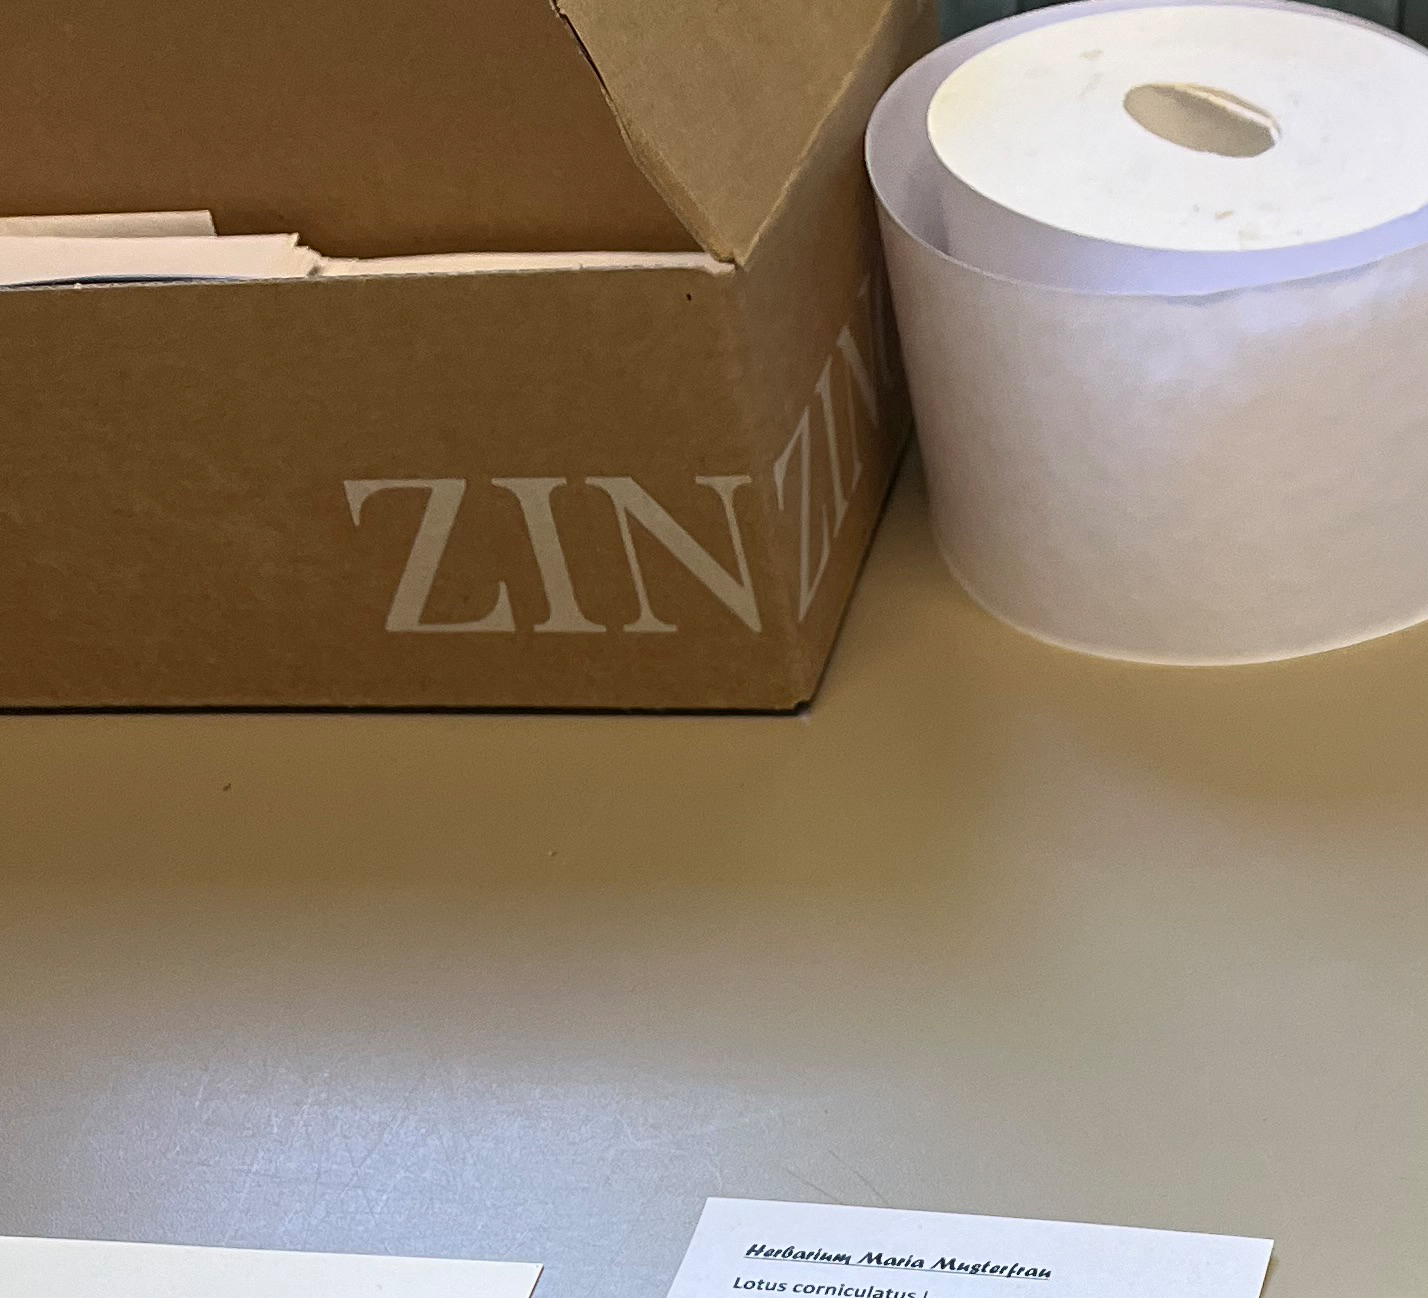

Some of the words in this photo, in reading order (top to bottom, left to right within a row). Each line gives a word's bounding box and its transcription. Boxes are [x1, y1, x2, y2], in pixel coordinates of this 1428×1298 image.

[343, 476, 763, 635] ZIN
[746, 1244, 852, 1265] Herbarium
[858, 1251, 925, 1269] Maria
[931, 1256, 1052, 1279] Musterfrau
[732, 1277, 787, 1293] Lotus
